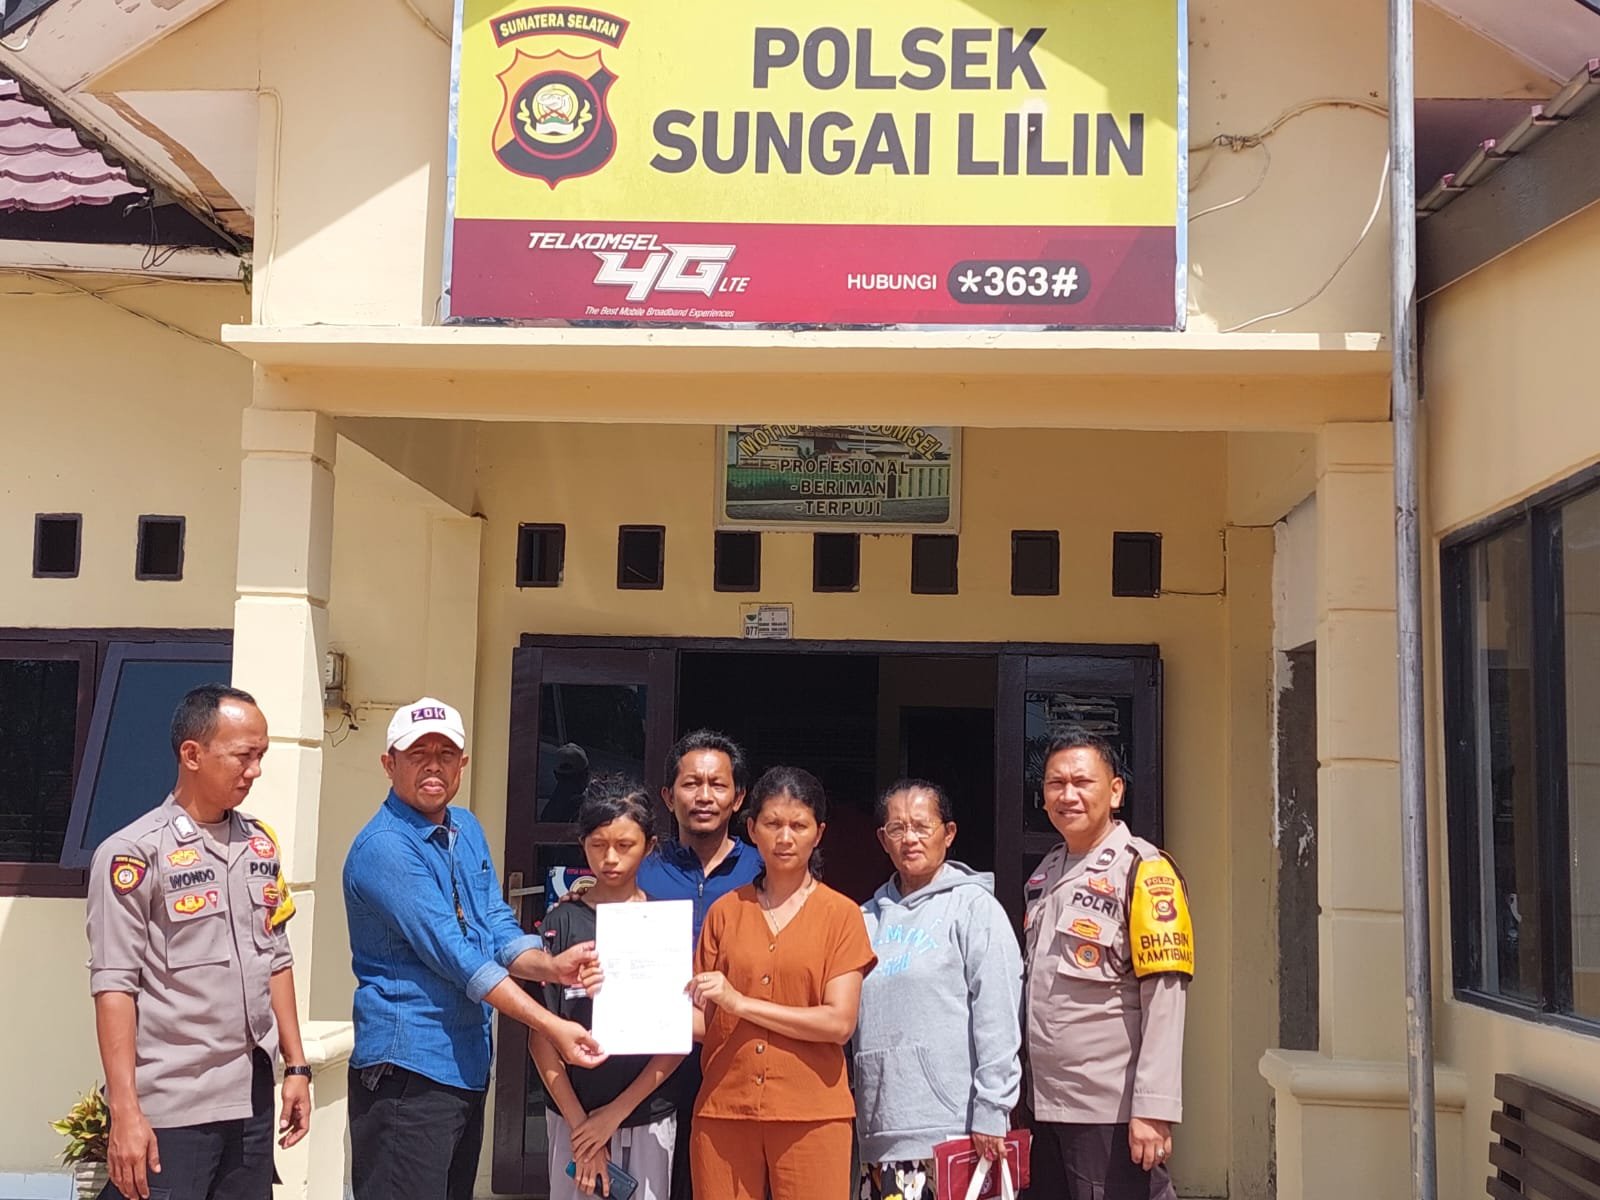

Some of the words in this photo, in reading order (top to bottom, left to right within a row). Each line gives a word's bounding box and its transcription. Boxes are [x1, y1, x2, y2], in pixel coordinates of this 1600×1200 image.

[500, 13, 565, 37] SUMATERA
[567, 14, 620, 38] SELATAN
[753, 27, 1047, 90] POLSEK
[650, 109, 931, 175] SUNGAI
[957, 112, 1144, 176] LILIN
[528, 232, 662, 250] TELKOMSEL
[592, 243, 737, 301] 4G
[847, 274, 937, 290] HUBUNGI
[718, 277, 751, 292] LTE
[585, 306, 599, 315] The
[600, 306, 619, 316] Best
[619, 307, 646, 317] Mobile
[646, 307, 687, 317] Broadband
[689, 308, 735, 318] Experiences
[169, 869, 215, 889] WONDO
[1072, 892, 1118, 917] POLRI
